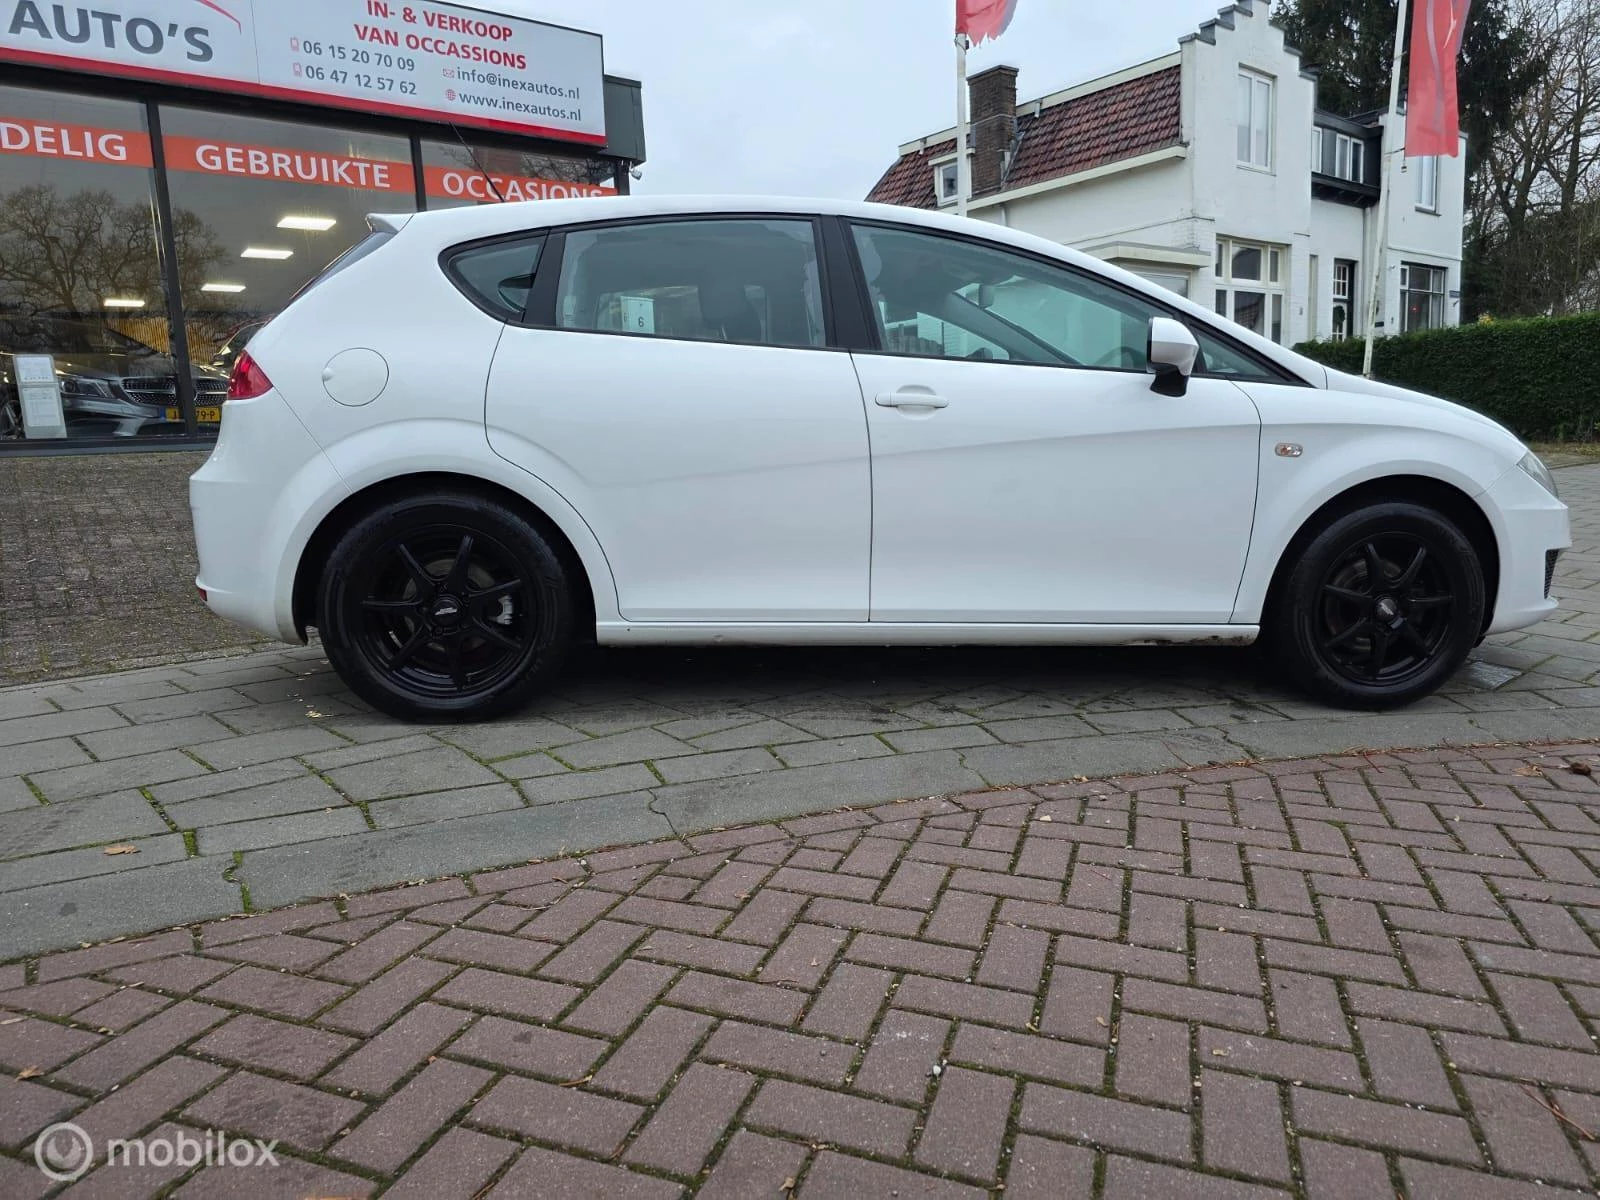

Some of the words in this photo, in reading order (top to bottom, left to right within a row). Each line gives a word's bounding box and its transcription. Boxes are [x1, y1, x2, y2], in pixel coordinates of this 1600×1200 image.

[8, 0, 214, 62] AUTO'S
[367, 0, 396, 18] IN-
[402, 7, 417, 24] &
[423, 10, 513, 42] VERKOOP
[303, 40, 322, 56] 06
[328, 45, 346, 60] 15
[351, 49, 370, 64] 20
[374, 53, 393, 68] 70
[397, 57, 415, 72] 09
[354, 24, 399, 47] VAN
[405, 34, 527, 70] OCCASSIONS
[305, 65, 325, 81] 06
[330, 70, 348, 84] 47
[354, 74, 373, 89] 12
[377, 77, 394, 91] 57
[399, 81, 417, 95] 62
[457, 67, 580, 100] info@inexautos.nl
[459, 92, 582, 121] www.inexautos.nl
[0, 122, 127, 161] DELIG
[195, 144, 390, 188] GEBRUIKTE
